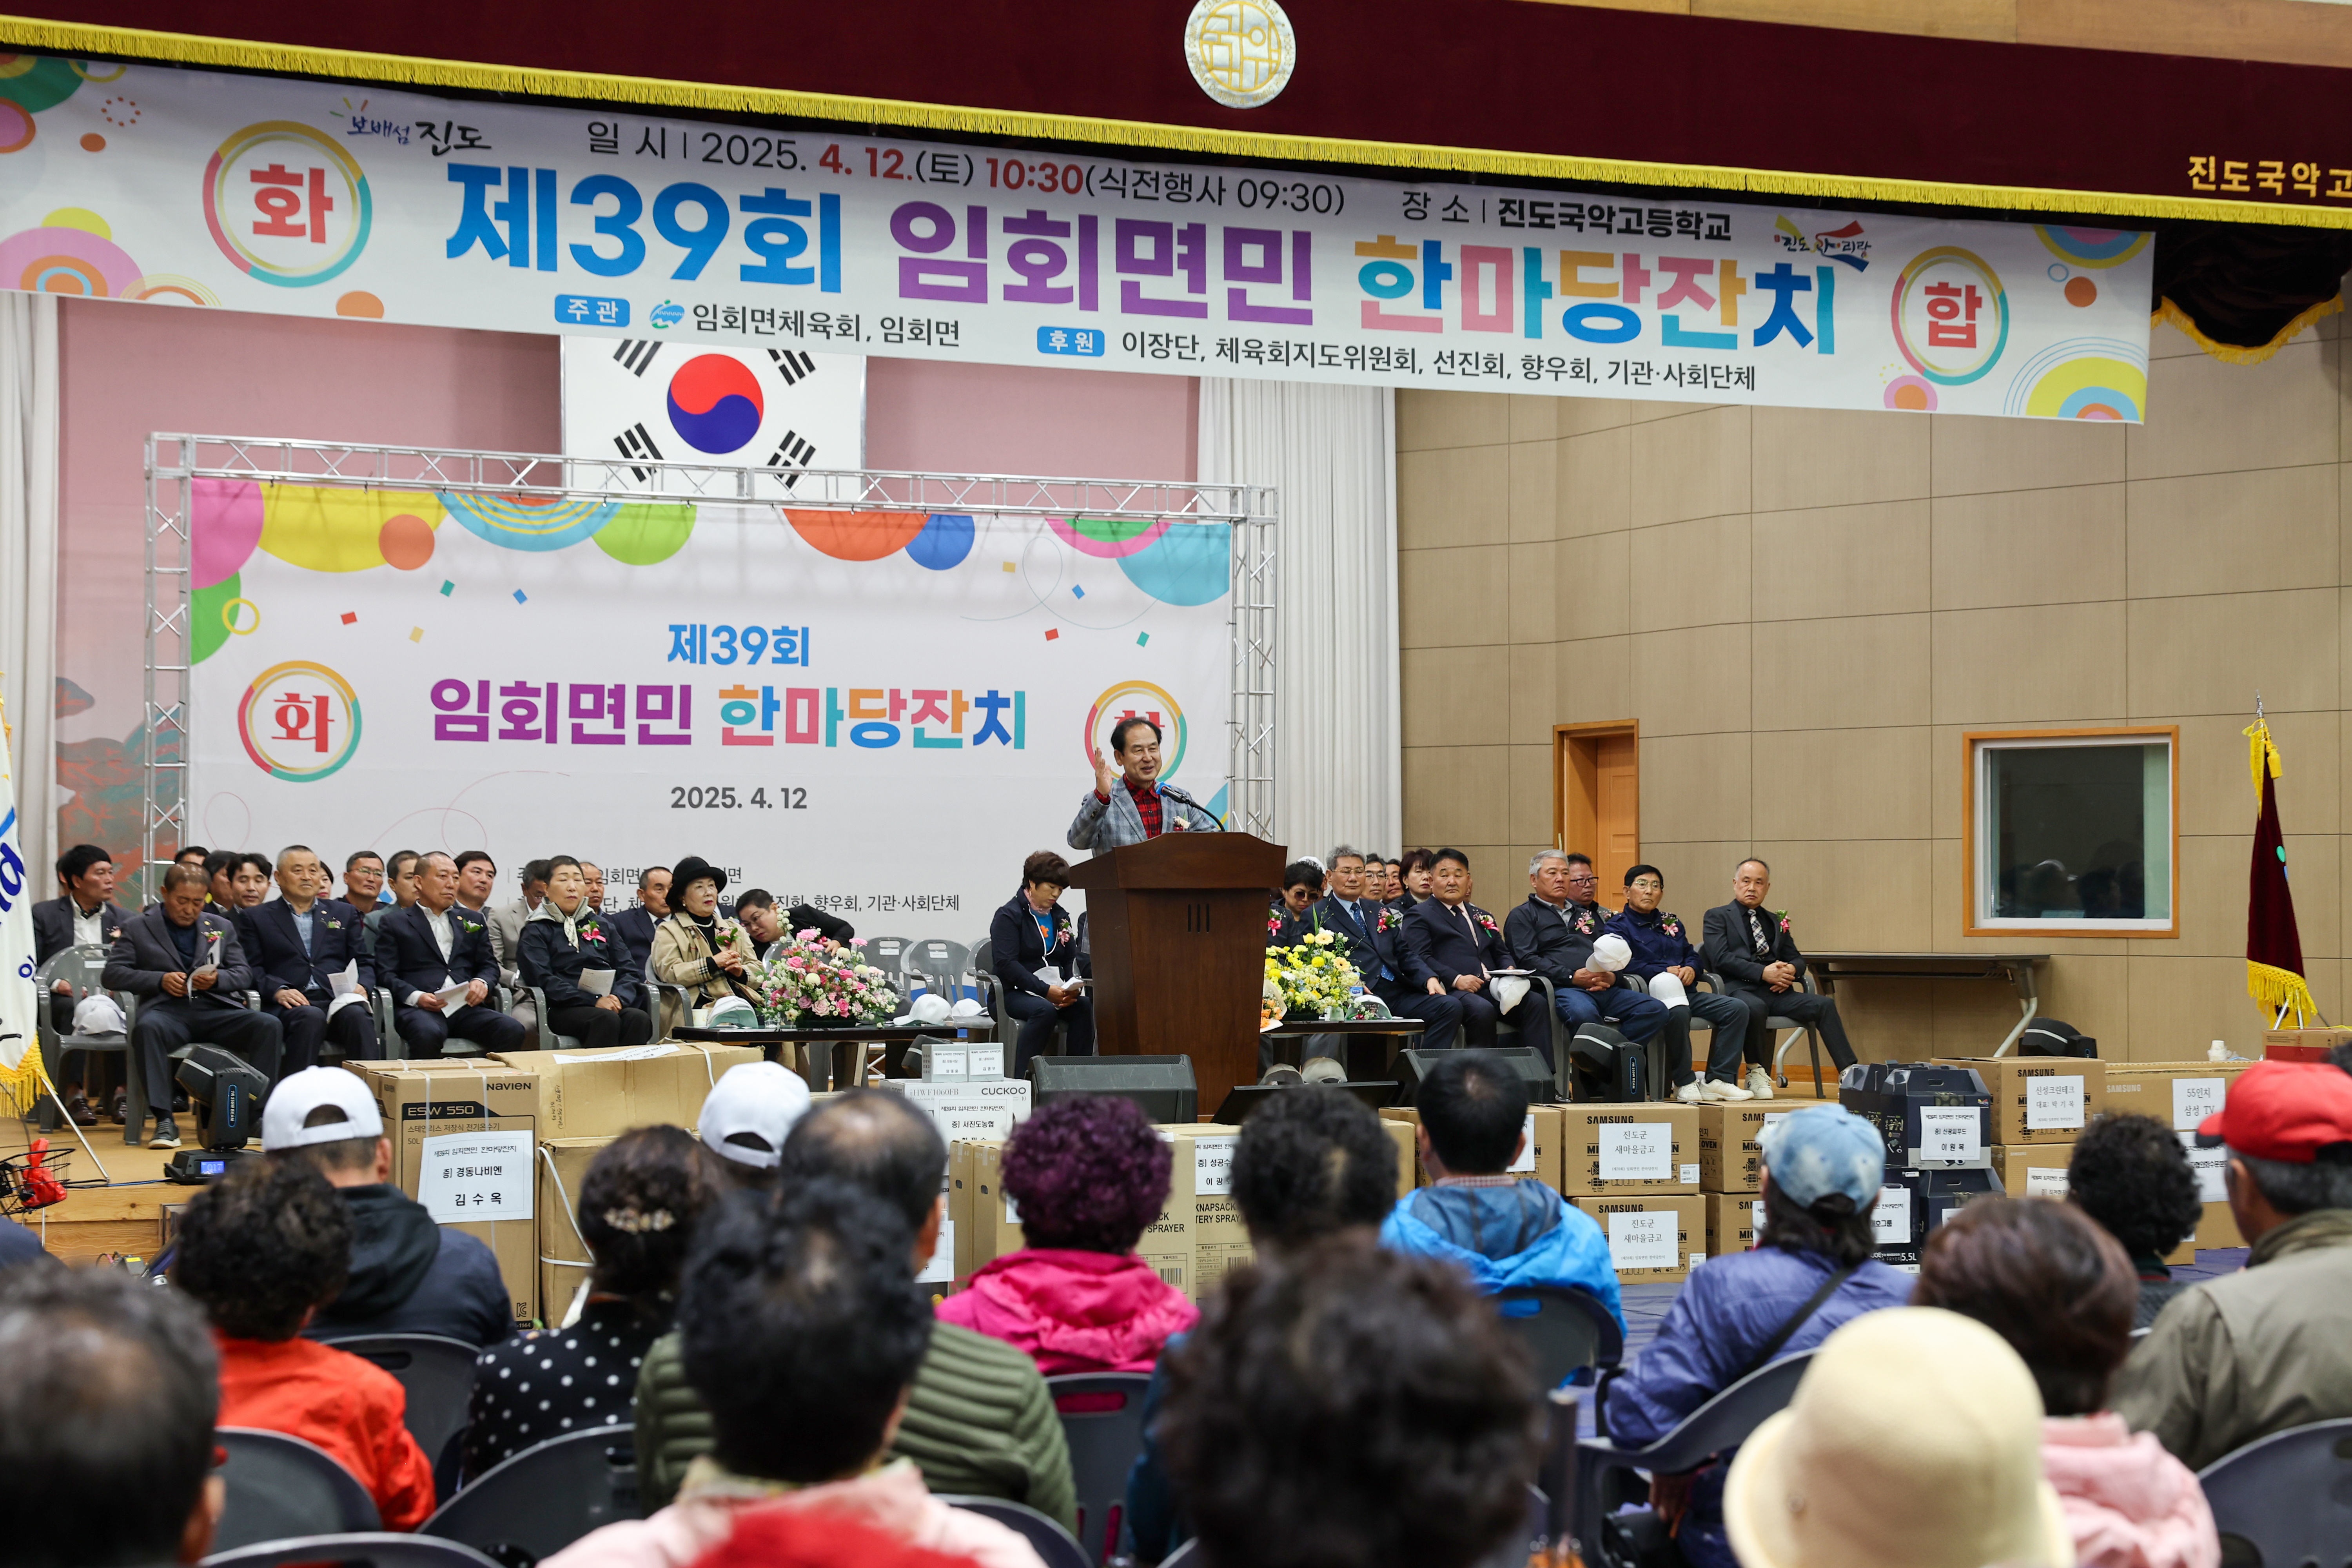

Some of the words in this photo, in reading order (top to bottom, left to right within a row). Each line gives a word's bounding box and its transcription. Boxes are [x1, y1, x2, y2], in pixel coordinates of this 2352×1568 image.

[415, 120, 492, 156] 진도
[702, 132, 807, 171] 2025.
[2187, 155, 2352, 198] 진도국악고
[249, 163, 333, 244] 화
[1497, 198, 1732, 241] 진도국악고등학교
[446, 162, 841, 293] 제39회
[890, 200, 1313, 326] 임회면민
[1355, 234, 1834, 355] 한마당잔치
[1924, 282, 1982, 348] 합
[693, 304, 872, 342] 임회면체육회,
[879, 316, 960, 348] 임회면
[1122, 330, 1205, 364] 이장단,
[1216, 336, 1423, 375] 체육회지도위원회,
[1434, 349, 1512, 380] 선진회,
[1521, 354, 1598, 384] 향우회,
[1608, 359, 1756, 391] 기관·사회단체
[668, 624, 809, 666] 제39회
[430, 679, 691, 745] 임회면민
[719, 684, 1025, 750] 한마당잔치
[271, 692, 335, 753] 화
[671, 786, 742, 809] 2025.
[781, 787, 807, 809] 12
[867, 895, 959, 911] 기관·사회단체
[2018, 1069, 2054, 1077] SAMSUNG
[982, 1087, 1026, 1095] CUCKOO
[2036, 1086, 2075, 1095] 신성크린테크
[2107, 1084, 2141, 1093] SAMSUNG
[2187, 1088, 2211, 1098] 55인치
[408, 1106, 442, 1116] ESW
[446, 1105, 474, 1115] 550
[2184, 1105, 2199, 1116] 삼성
[2203, 1105, 2215, 1114] TV
[1587, 1116, 1634, 1124] SAMSUNG
[1742, 1113, 1765, 1122] SAMS
[1623, 1131, 1648, 1140] 진도군
[1615, 1145, 1655, 1154] 새마을금고
[456, 1166, 502, 1177] 경동나비엔
[1599, 1204, 1643, 1213] SAMSUNG
[1215, 1214, 1240, 1223] SPRAY
[1148, 1224, 1184, 1233] SPRAYER
[1632, 1220, 1655, 1229] 진도군
[1624, 1234, 1662, 1243] 새마을금고
[1901, 1252, 1917, 1261] 5.5L
